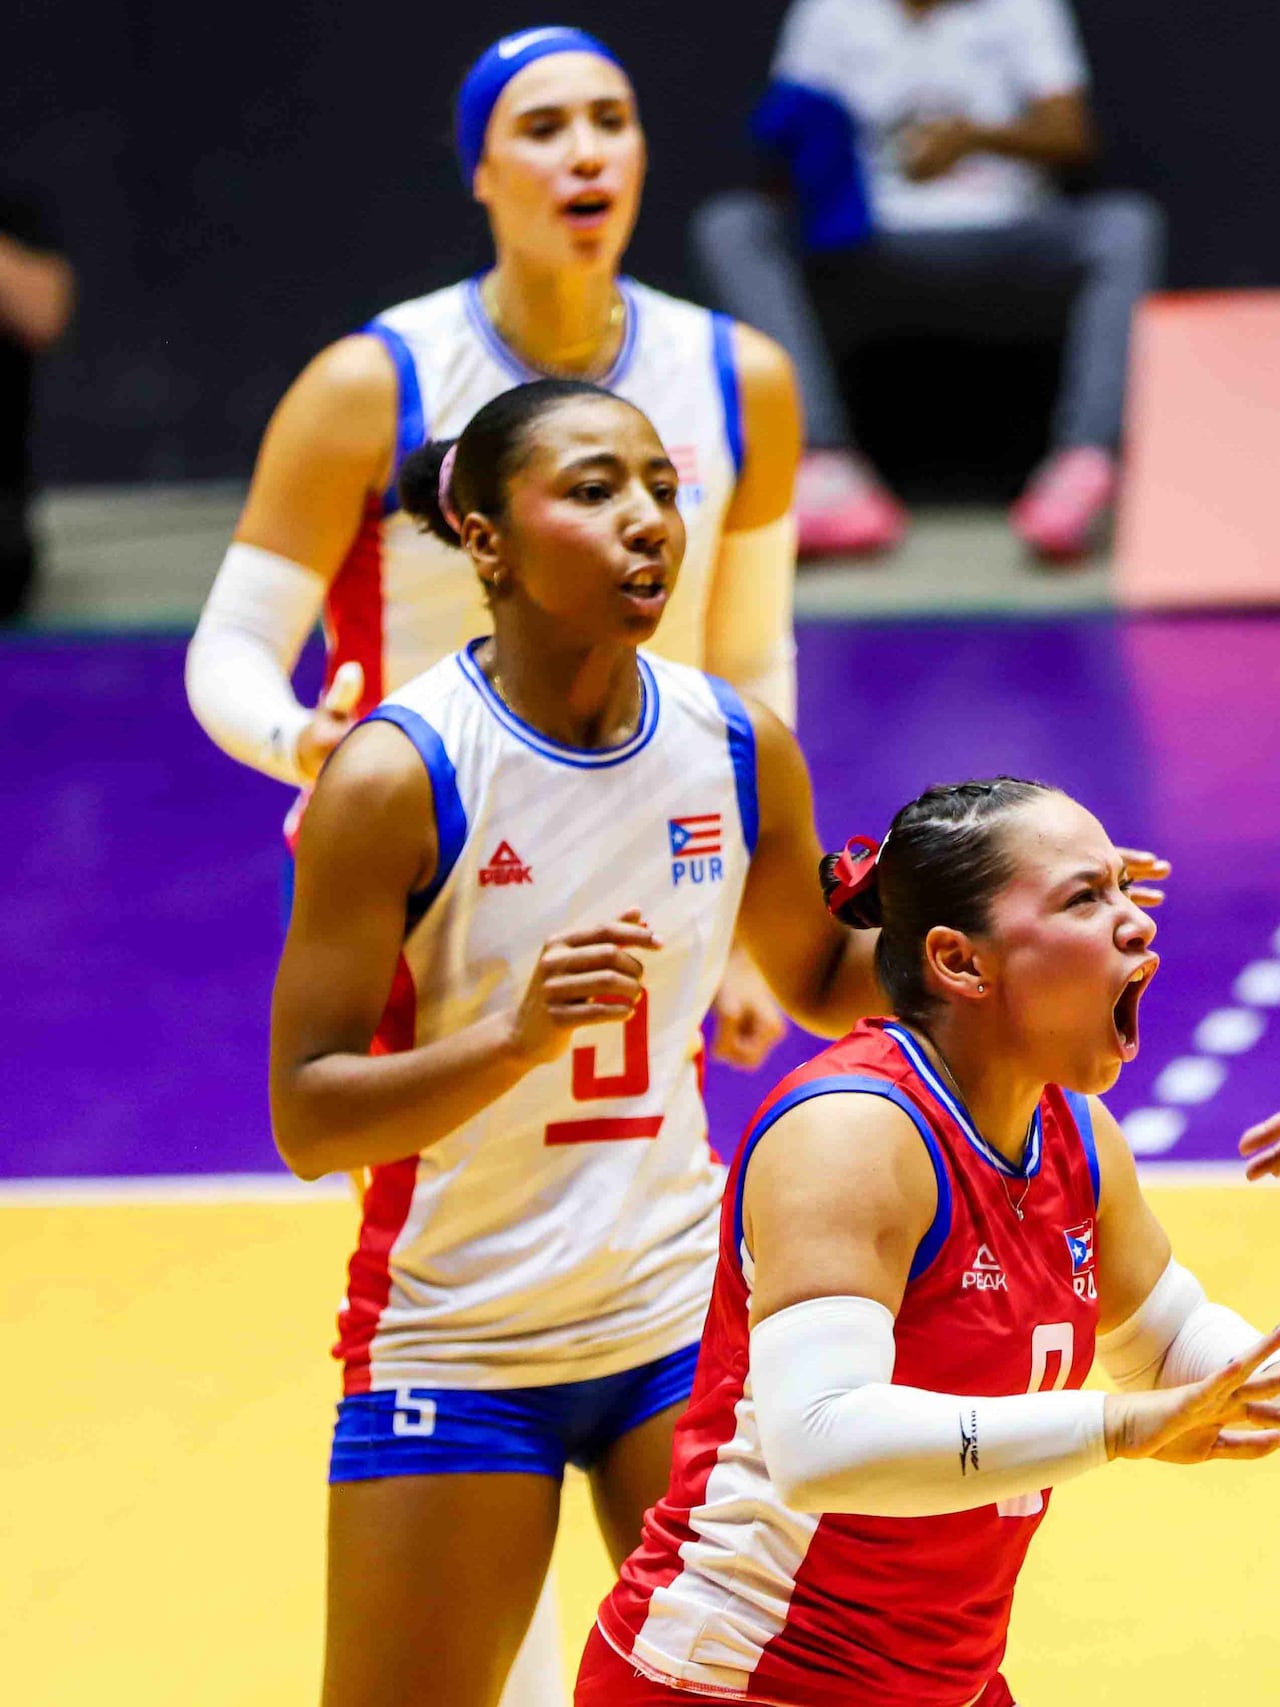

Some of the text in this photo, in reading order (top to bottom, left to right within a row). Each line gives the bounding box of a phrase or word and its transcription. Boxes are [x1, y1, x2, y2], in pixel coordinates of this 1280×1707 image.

[672, 857, 723, 887] PUR
[962, 1271, 1008, 1292] PEAK
[393, 1388, 436, 1436] 5
